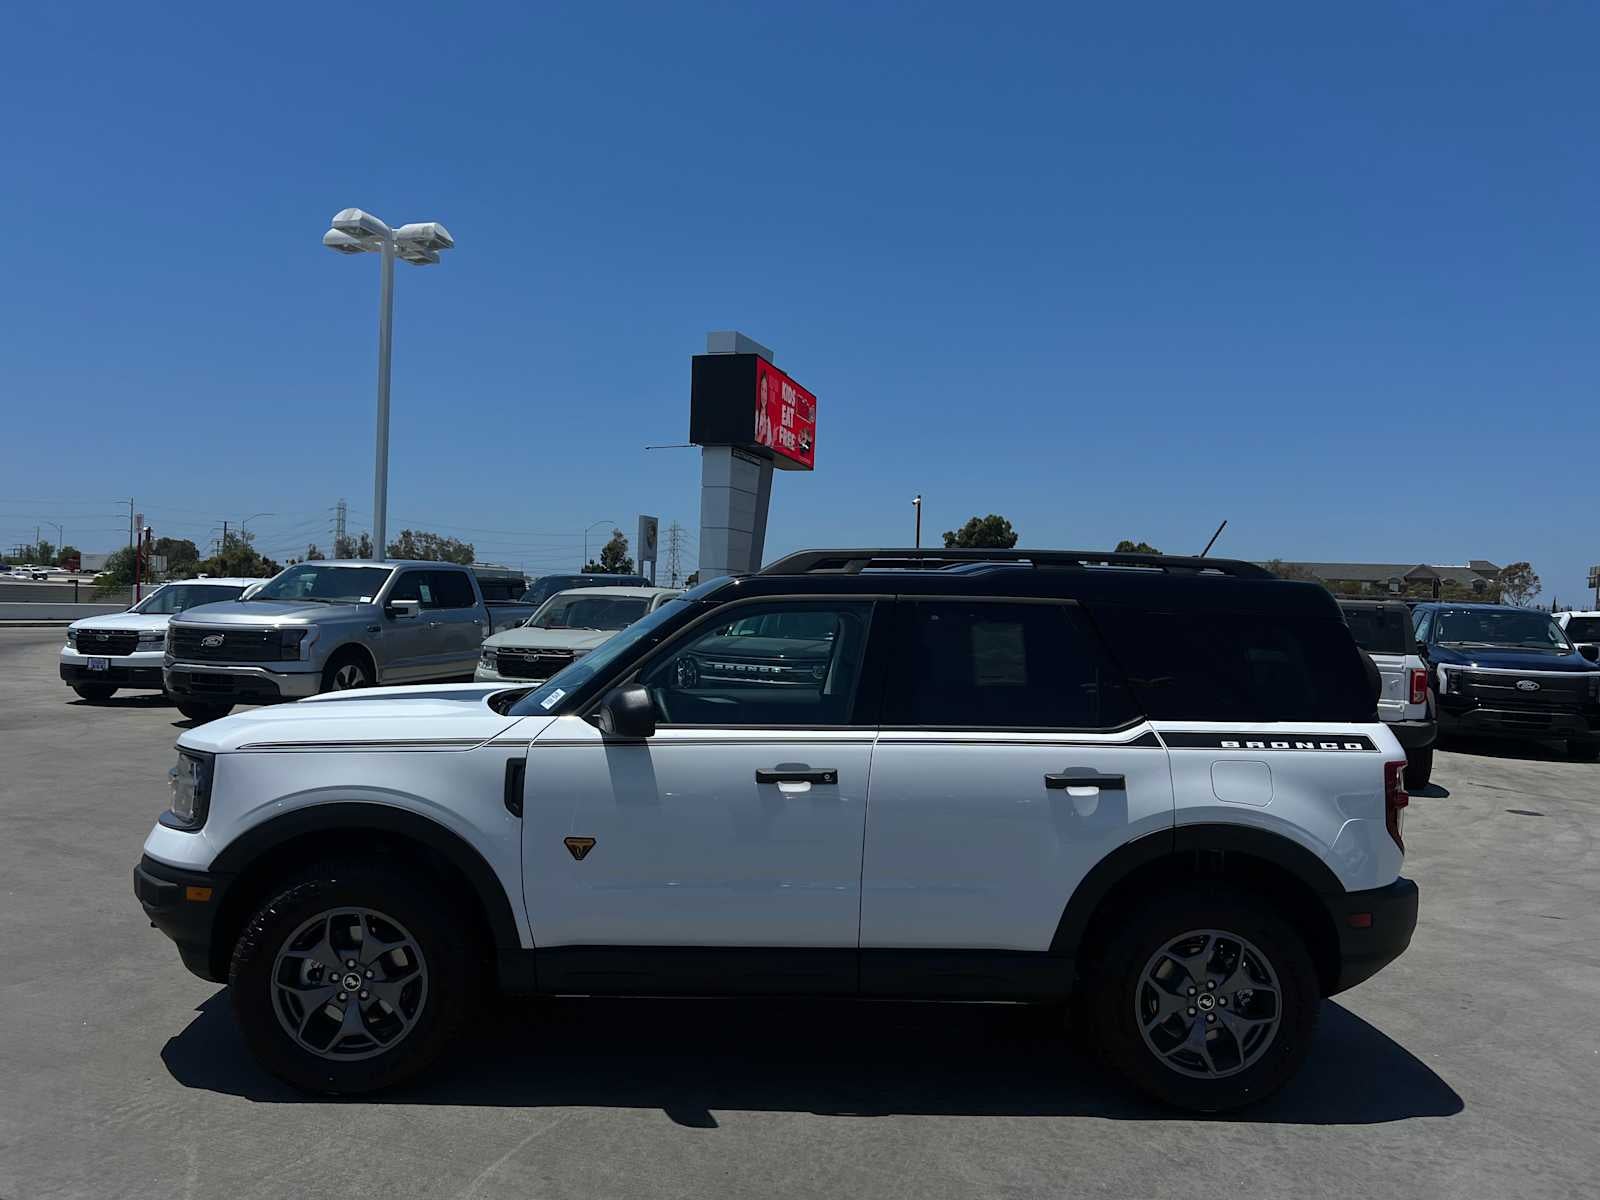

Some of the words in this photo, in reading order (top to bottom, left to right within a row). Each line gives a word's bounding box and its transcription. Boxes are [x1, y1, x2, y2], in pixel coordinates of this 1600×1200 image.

[782, 381, 796, 406] KIDS
[781, 405, 795, 428] EAT
[779, 427, 796, 450] FREE
[1221, 741, 1363, 750] BRONCO
